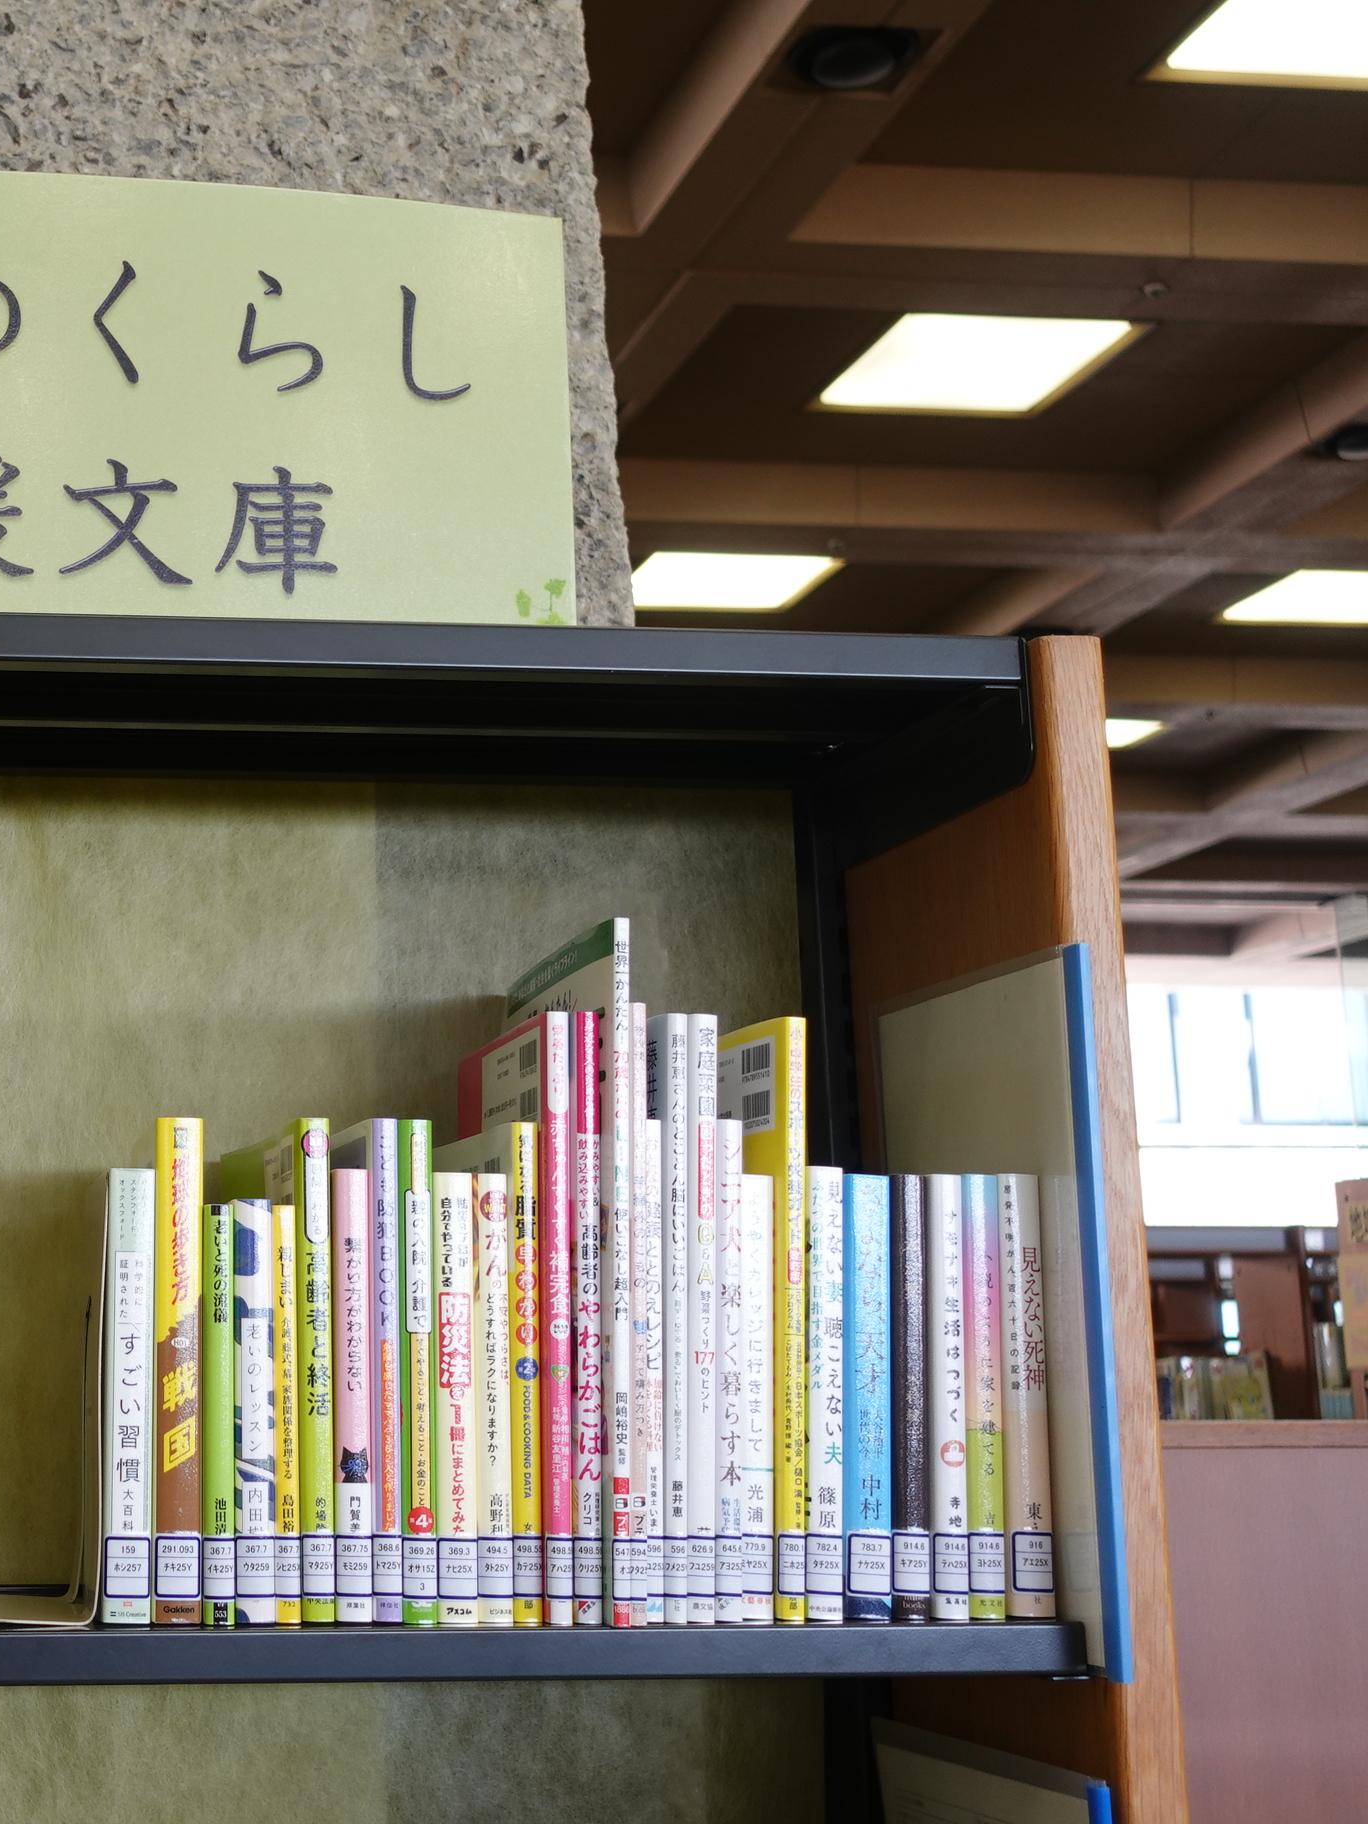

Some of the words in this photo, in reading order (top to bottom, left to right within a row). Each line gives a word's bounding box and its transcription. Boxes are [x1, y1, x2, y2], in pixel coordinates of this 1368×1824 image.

[698, 1027, 715, 1117] 家庭菜園
[172, 1157, 189, 1306] 地球の歩き方
[440, 1197, 453, 1289] 自分でやっている
[825, 1180, 844, 1304] 見えない妻
[213, 1219, 229, 1324] 老いと死の流儀
[118, 1258, 130, 1320] 証明された
[343, 1237, 363, 1392] 繋がり方がわからない
[1021, 1246, 1046, 1392] 見えない死神
[305, 1251, 330, 1417] 高齢者と終活
[245, 1323, 263, 1453] 老いのレッスン
[823, 1315, 844, 1466] 聴こえない夫
[162, 1360, 198, 1473] 戦国
[615, 1391, 628, 1445] 岡嶋裕史
[671, 1480, 683, 1518] 藤井恵
[860, 1474, 883, 1521] 中村
[582, 1491, 593, 1525] クリコ
[747, 1483, 764, 1524] 光浦
[817, 1486, 837, 1529] 篠原
[281, 1495, 295, 1534] 島田裕
[948, 1496, 963, 1528] 寺地
[121, 1545, 137, 1555] 159
[161, 1544, 195, 1555] 291.093
[245, 1544, 268, 1554] 367.7
[278, 1544, 300, 1554] 367.7
[310, 1543, 333, 1553] 367.7
[341, 1543, 369, 1554] 367.75
[378, 1542, 400, 1553] 368.6
[485, 1545, 508, 1555] 494.5
[670, 1545, 686, 1554] 596
[691, 1544, 714, 1554] 626.9
[744, 1542, 766, 1552] 779.9
[816, 1542, 838, 1553] 782.4
[861, 1542, 883, 1552] 783.7
[903, 1542, 925, 1551] 914.6
[944, 1542, 966, 1552] 914.6
[978, 1541, 1000, 1551] 914.6
[1028, 1540, 1044, 1550] 916
[210, 1546, 233, 1556] 367.7
[408, 1546, 435, 1556] 369.26
[448, 1546, 471, 1557] 369.3
[113, 1562, 143, 1573] ホシ257
[243, 1562, 270, 1573] ウタ259
[342, 1562, 368, 1572] モミ259
[419, 1582, 425, 1592] 3
[162, 1604, 195, 1615] Gakken
[214, 1609, 228, 1619] 553
[445, 1606, 473, 1616] アスコム
